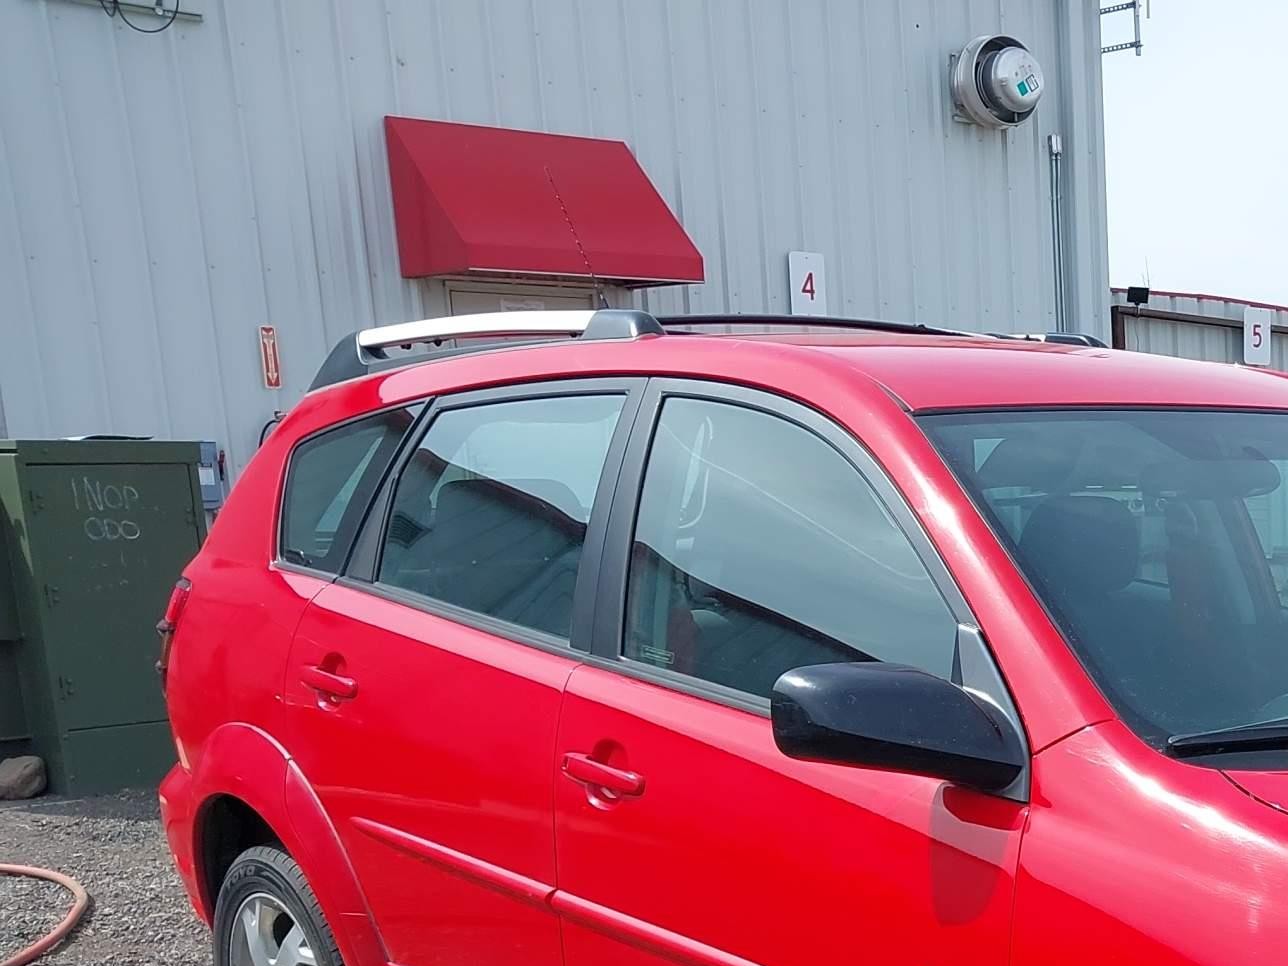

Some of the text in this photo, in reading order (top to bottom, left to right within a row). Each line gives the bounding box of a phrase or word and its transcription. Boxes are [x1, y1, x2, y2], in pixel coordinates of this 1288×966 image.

[801, 272, 815, 301] 4
[1252, 324, 1262, 348] 5
[71, 476, 139, 511] INOP
